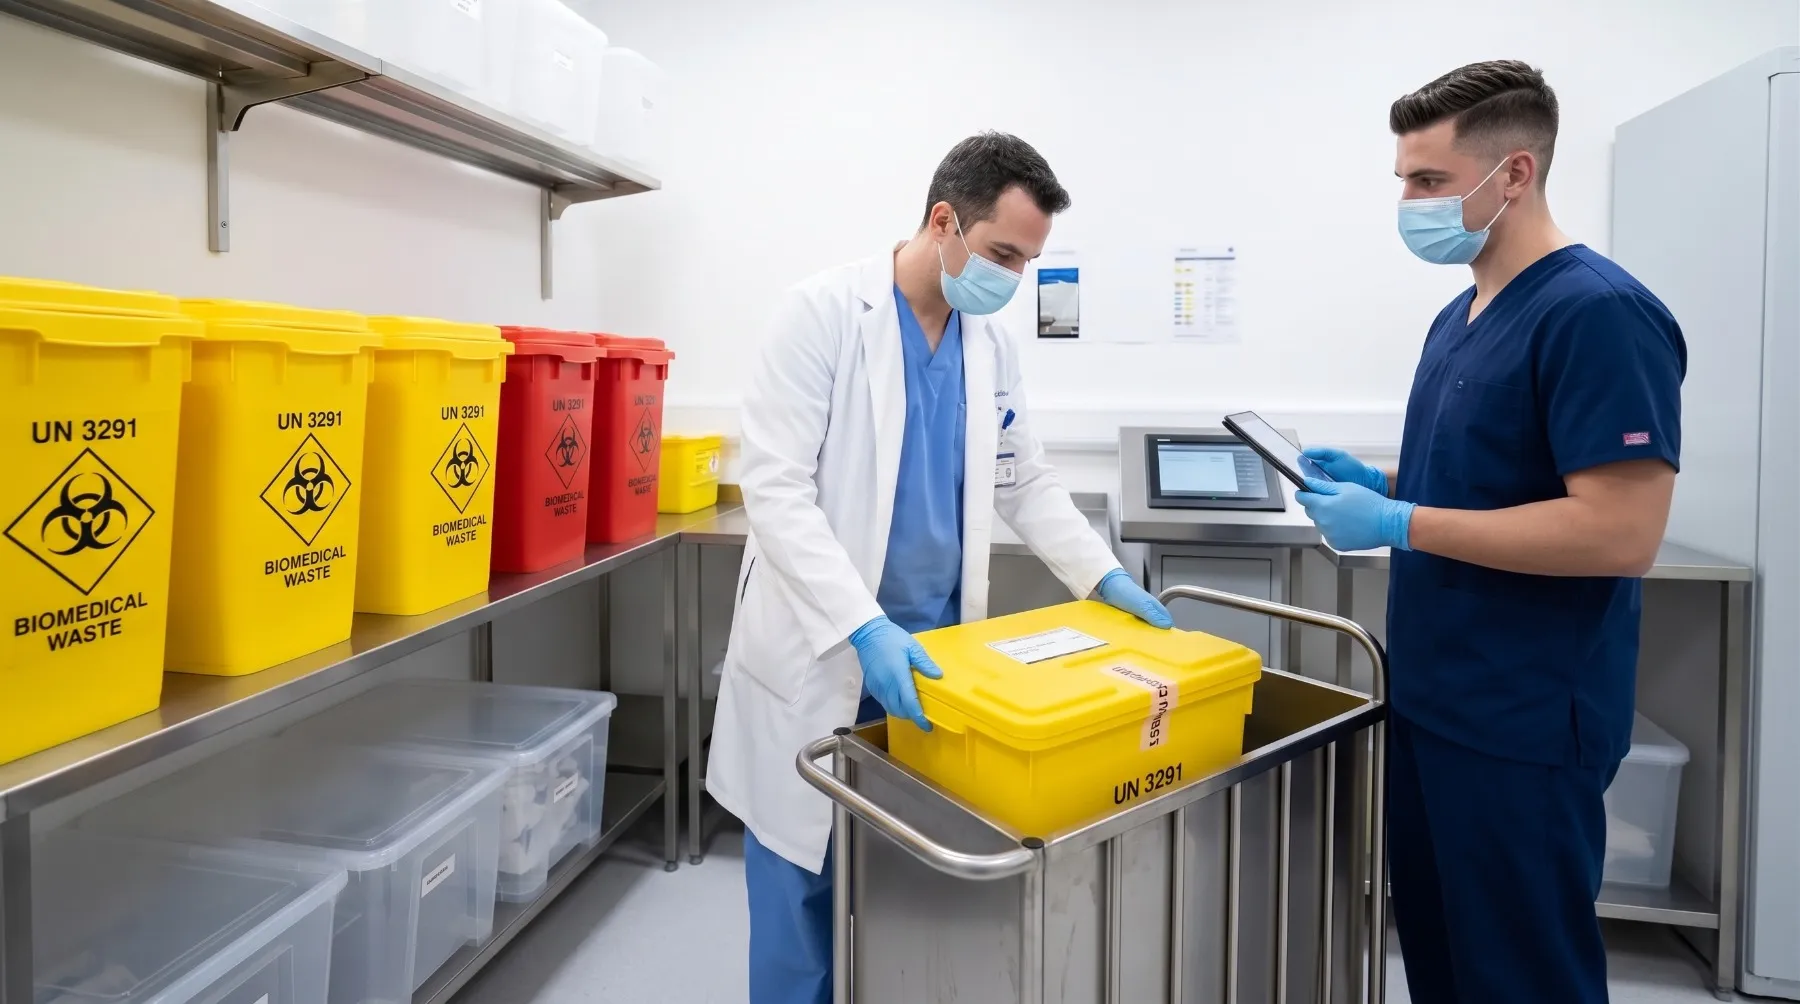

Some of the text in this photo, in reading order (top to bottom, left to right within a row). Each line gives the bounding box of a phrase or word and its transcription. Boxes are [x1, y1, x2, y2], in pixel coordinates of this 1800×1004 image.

[441, 405, 484, 420] UN 3291
[552, 398, 584, 412] UN 3291
[32, 418, 136, 444] UN 3291
[278, 411, 342, 430] UN 3291
[553, 503, 577, 517] WASTE
[432, 514, 487, 536] BIOMEDICAL
[446, 529, 477, 547] WASTE
[264, 545, 347, 576] BIOMEDICAL
[284, 565, 331, 588] WASTE
[14, 591, 148, 637] BIOMEDICAL
[46, 617, 122, 652] WASTE
[1114, 762, 1183, 805] UN 3291
